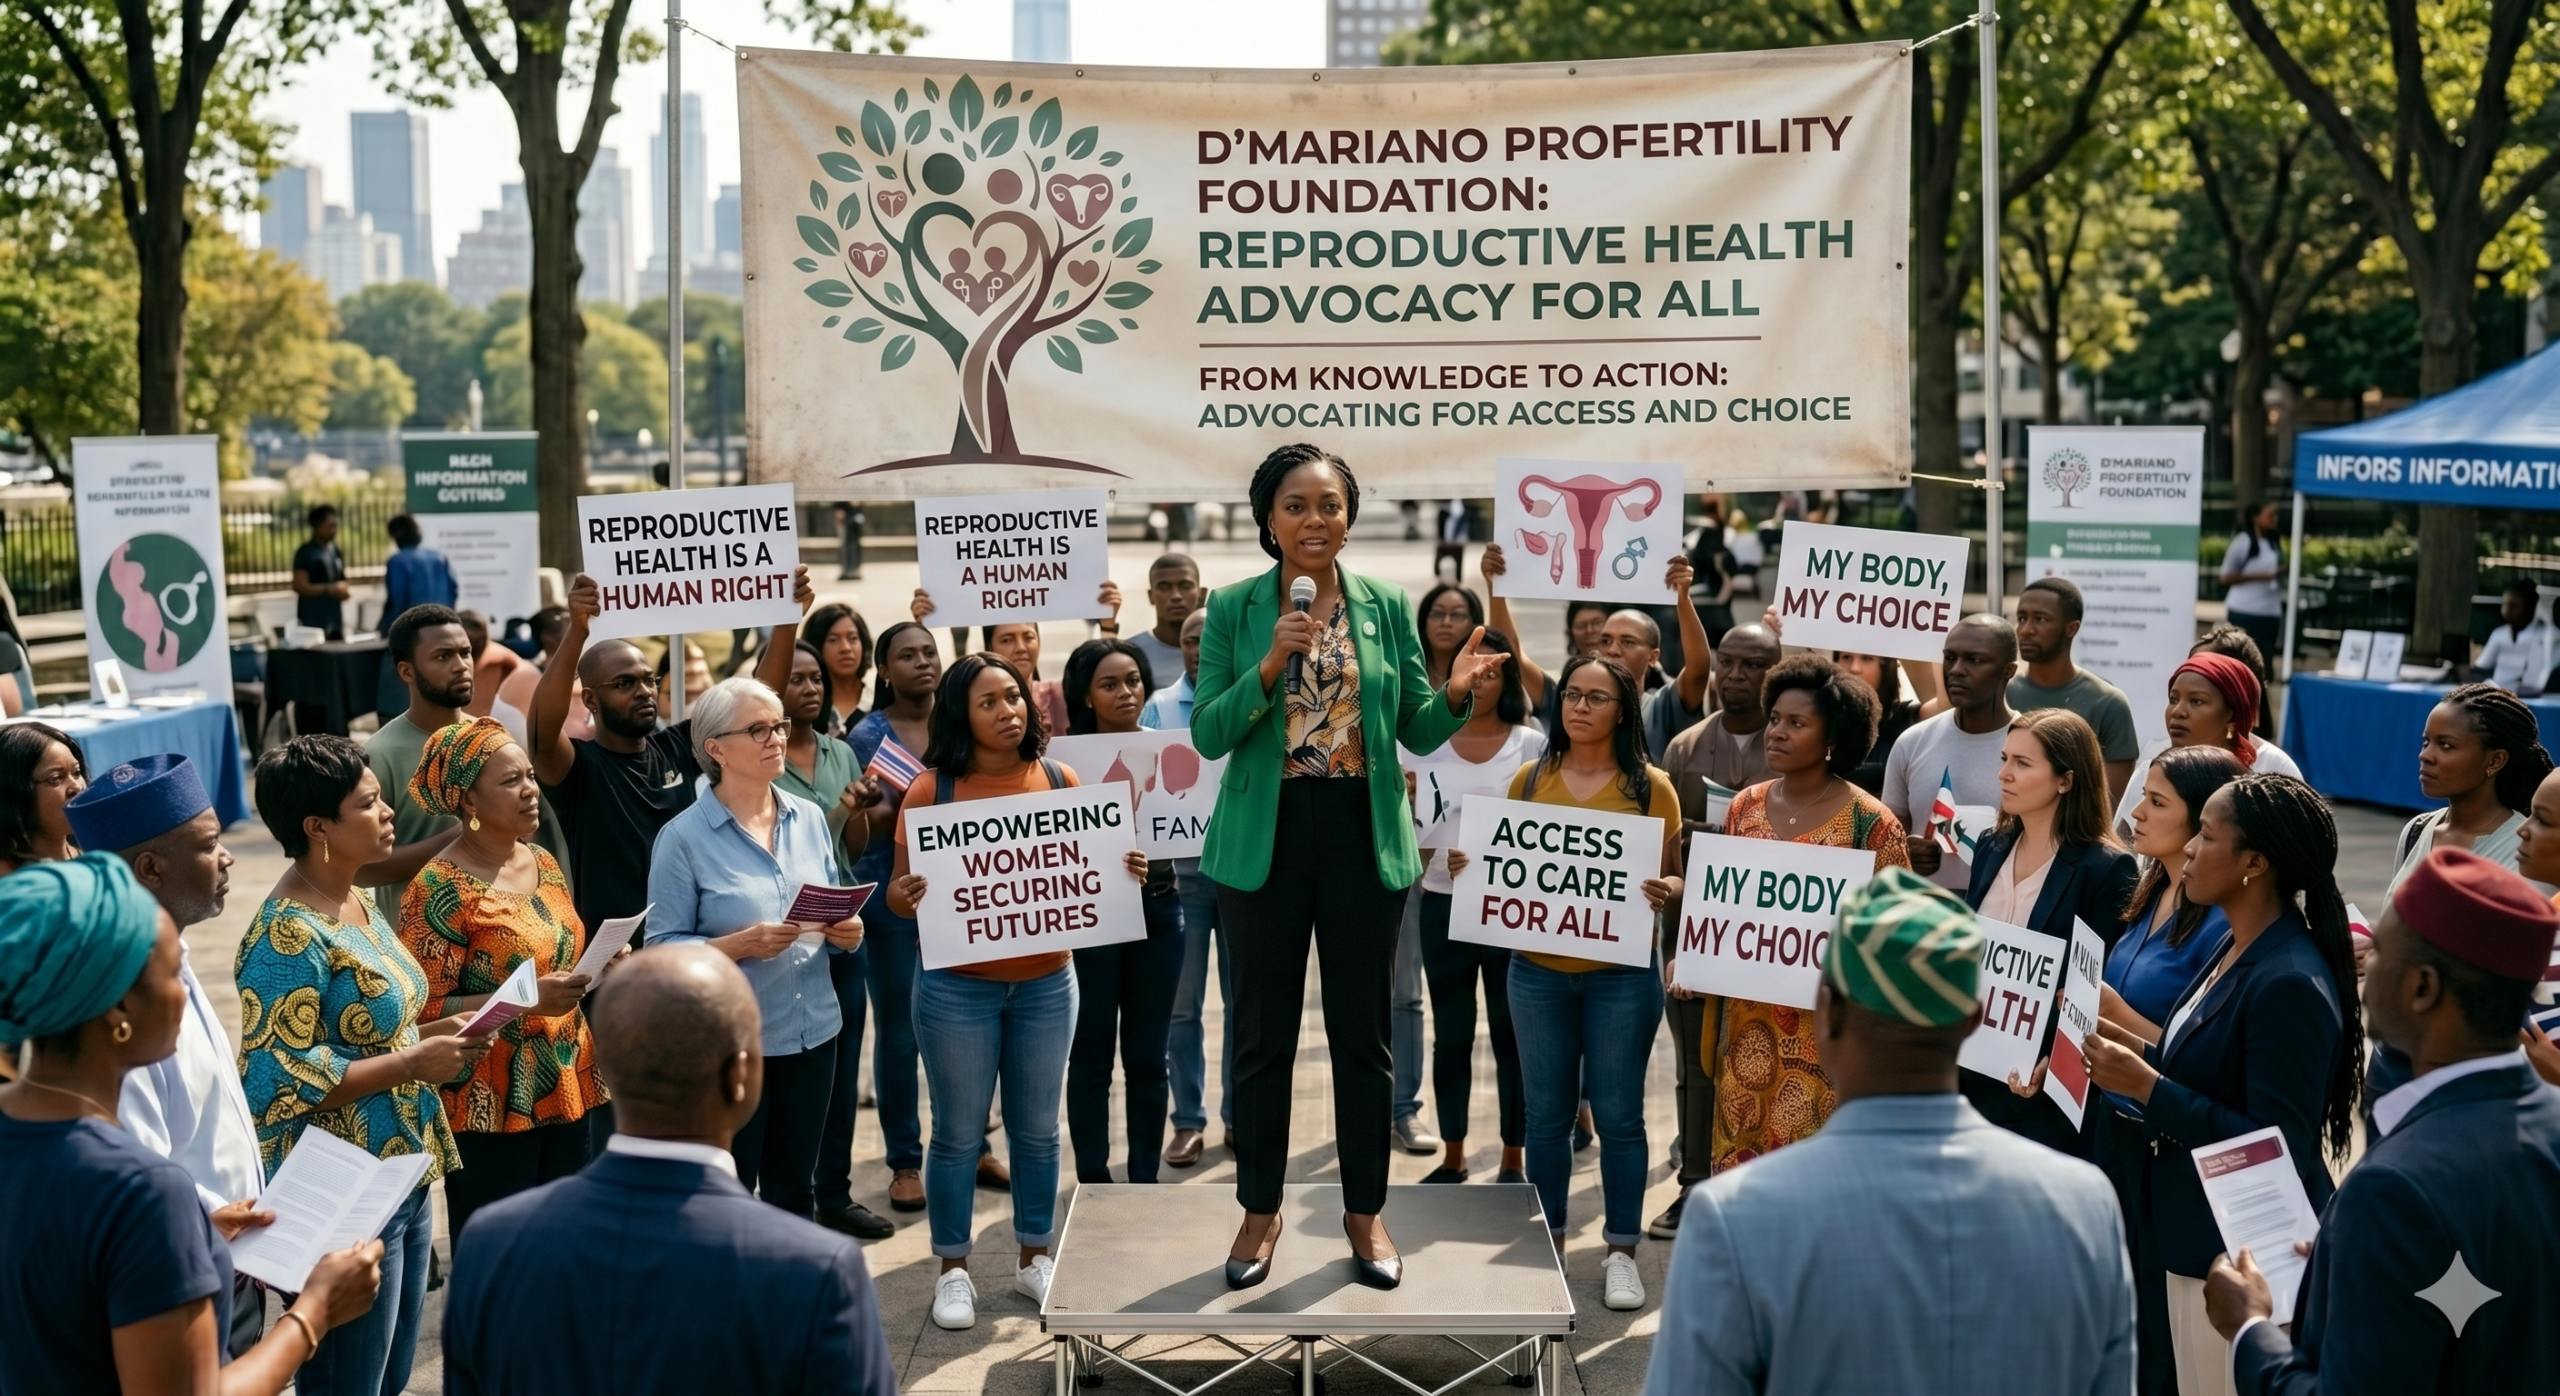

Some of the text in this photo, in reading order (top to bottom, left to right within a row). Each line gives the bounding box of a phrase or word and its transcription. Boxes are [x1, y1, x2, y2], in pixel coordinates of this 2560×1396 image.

[1198, 115, 1853, 164] D’MARIANO PROFERTILITY
[1198, 176, 1549, 214] FOUNDATION:
[1199, 220, 1853, 269] REPRODUCTIVE HEALTH
[1197, 278, 1760, 324] ADVOCACY FOR ALL
[1199, 362, 1728, 391] FROM KNOWLEDGE TO ACTION:
[1198, 396, 1852, 429] ADVOCATING FOR ACCESS AND CHOICE
[2099, 472, 2192, 484] PROFERTILITY
[2317, 455, 2560, 490] INFORS INFORMATI
[2099, 487, 2187, 499] FOUNDATION
[588, 507, 790, 543] REPRODUCTIVE
[925, 509, 1098, 536] REPRODUCTIVE
[615, 541, 774, 576] HEALTH IS A
[956, 535, 1071, 560] HEALTH IS
[961, 561, 1068, 586] A HUMAN
[1806, 547, 1949, 597] MY BODY,
[603, 574, 789, 611] HUMAN RIGHT
[982, 587, 1050, 609] RIGHT
[1782, 586, 1951, 633] MY CHOICE
[917, 801, 1122, 852] EMPOWERING
[1491, 817, 1623, 860] ACCESS
[961, 840, 1089, 879] WOMEN,
[1483, 855, 1628, 902] TO CARE
[953, 870, 1102, 913] SECURING
[1703, 864, 1847, 916] MY BODY
[966, 903, 1099, 944] FUTURES
[1481, 895, 1620, 942] FOR ALL
[1682, 915, 1730, 956] MY
[1983, 985, 2040, 1041] LTH
